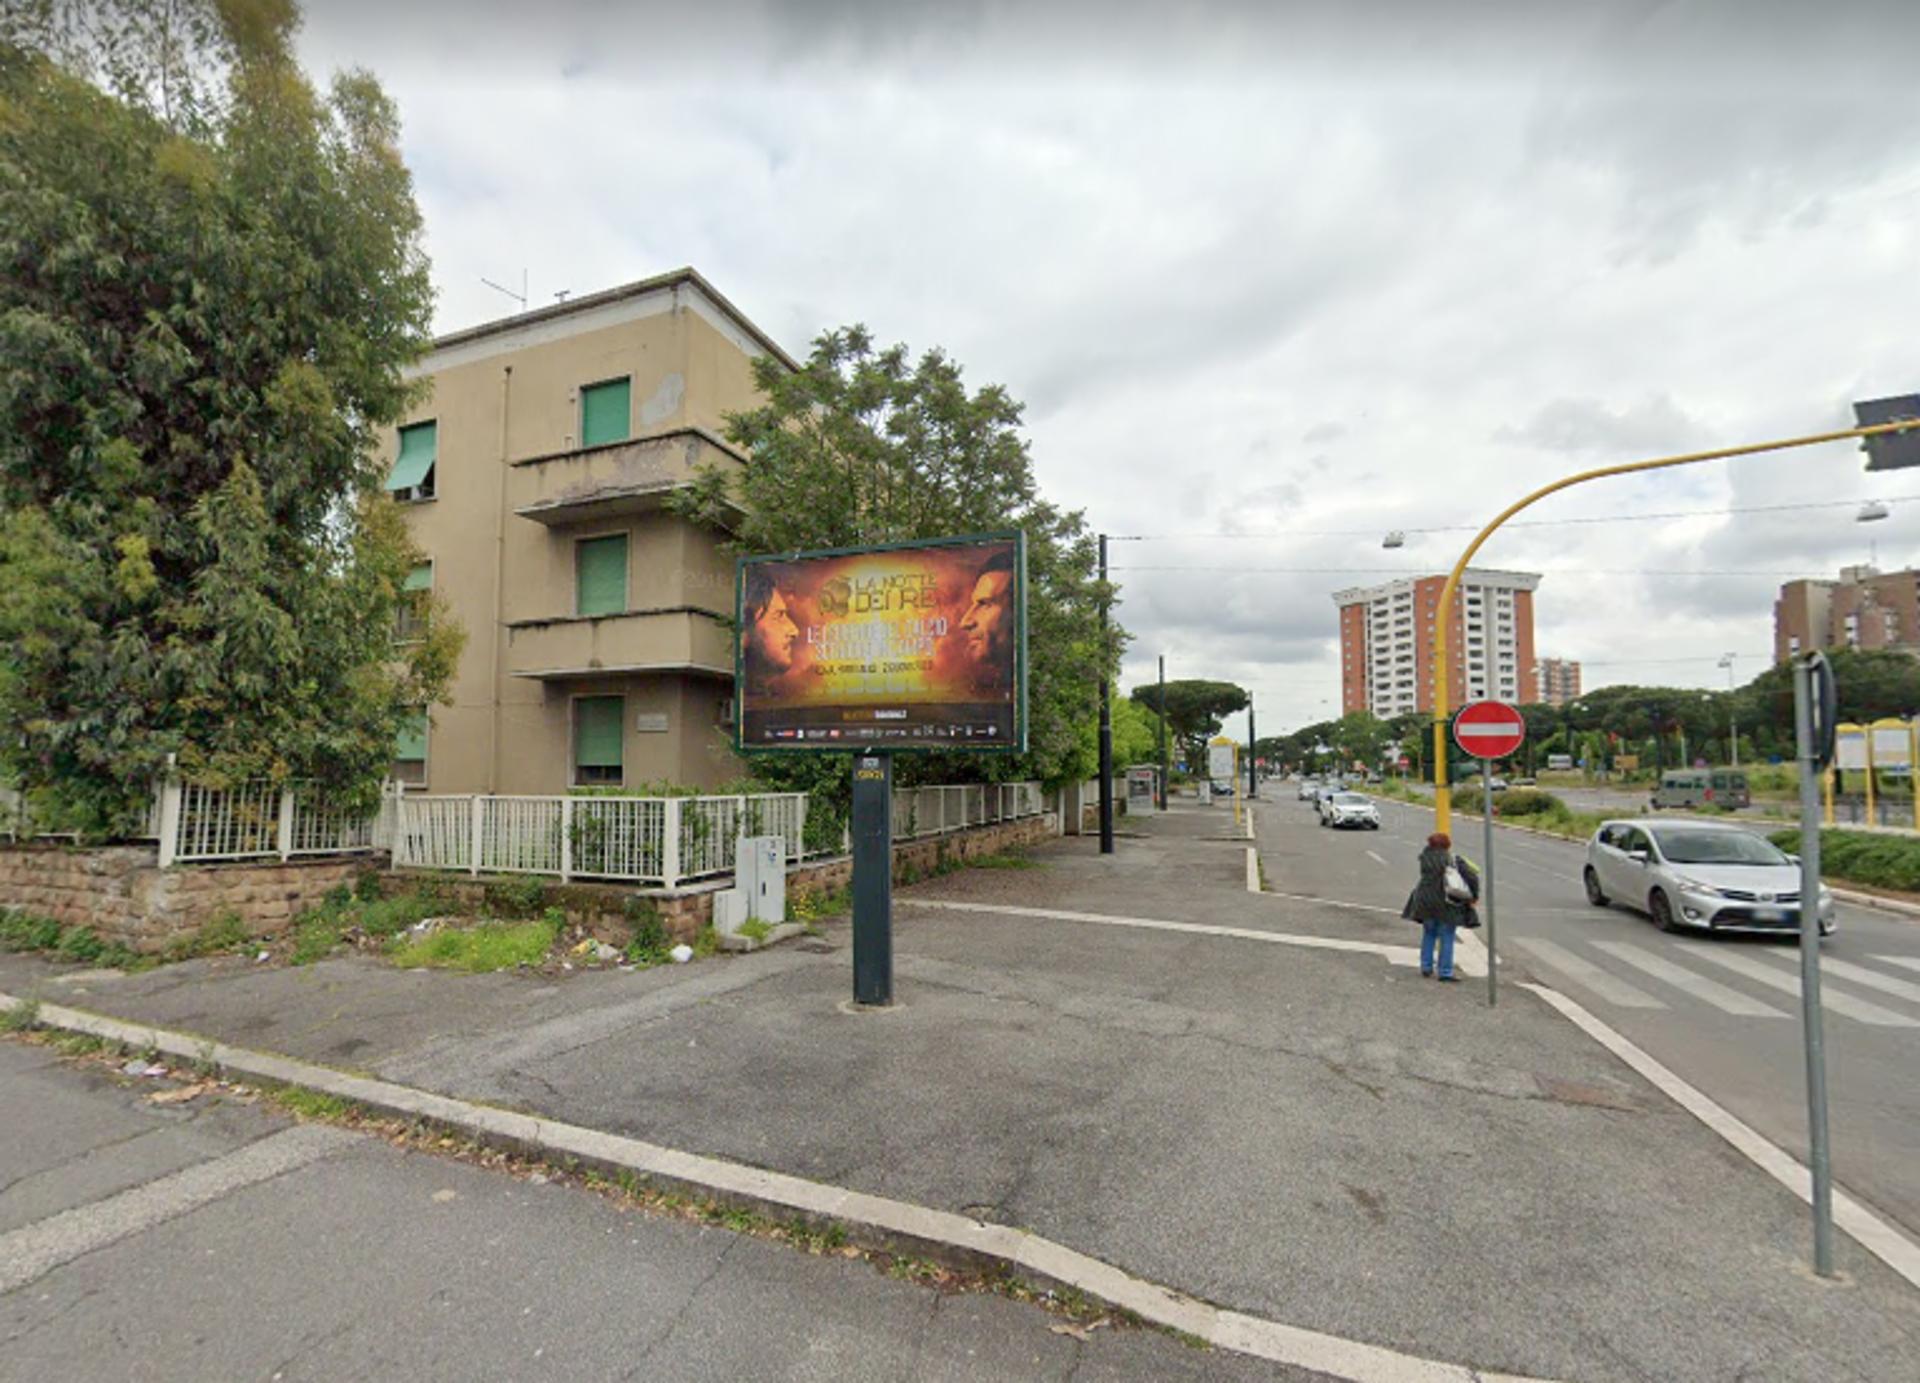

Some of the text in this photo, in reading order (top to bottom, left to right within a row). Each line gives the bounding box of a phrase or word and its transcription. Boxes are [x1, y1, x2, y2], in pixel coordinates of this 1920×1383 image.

[855, 573, 938, 592] LA NOTTE
[855, 586, 938, 613] DEI RE
